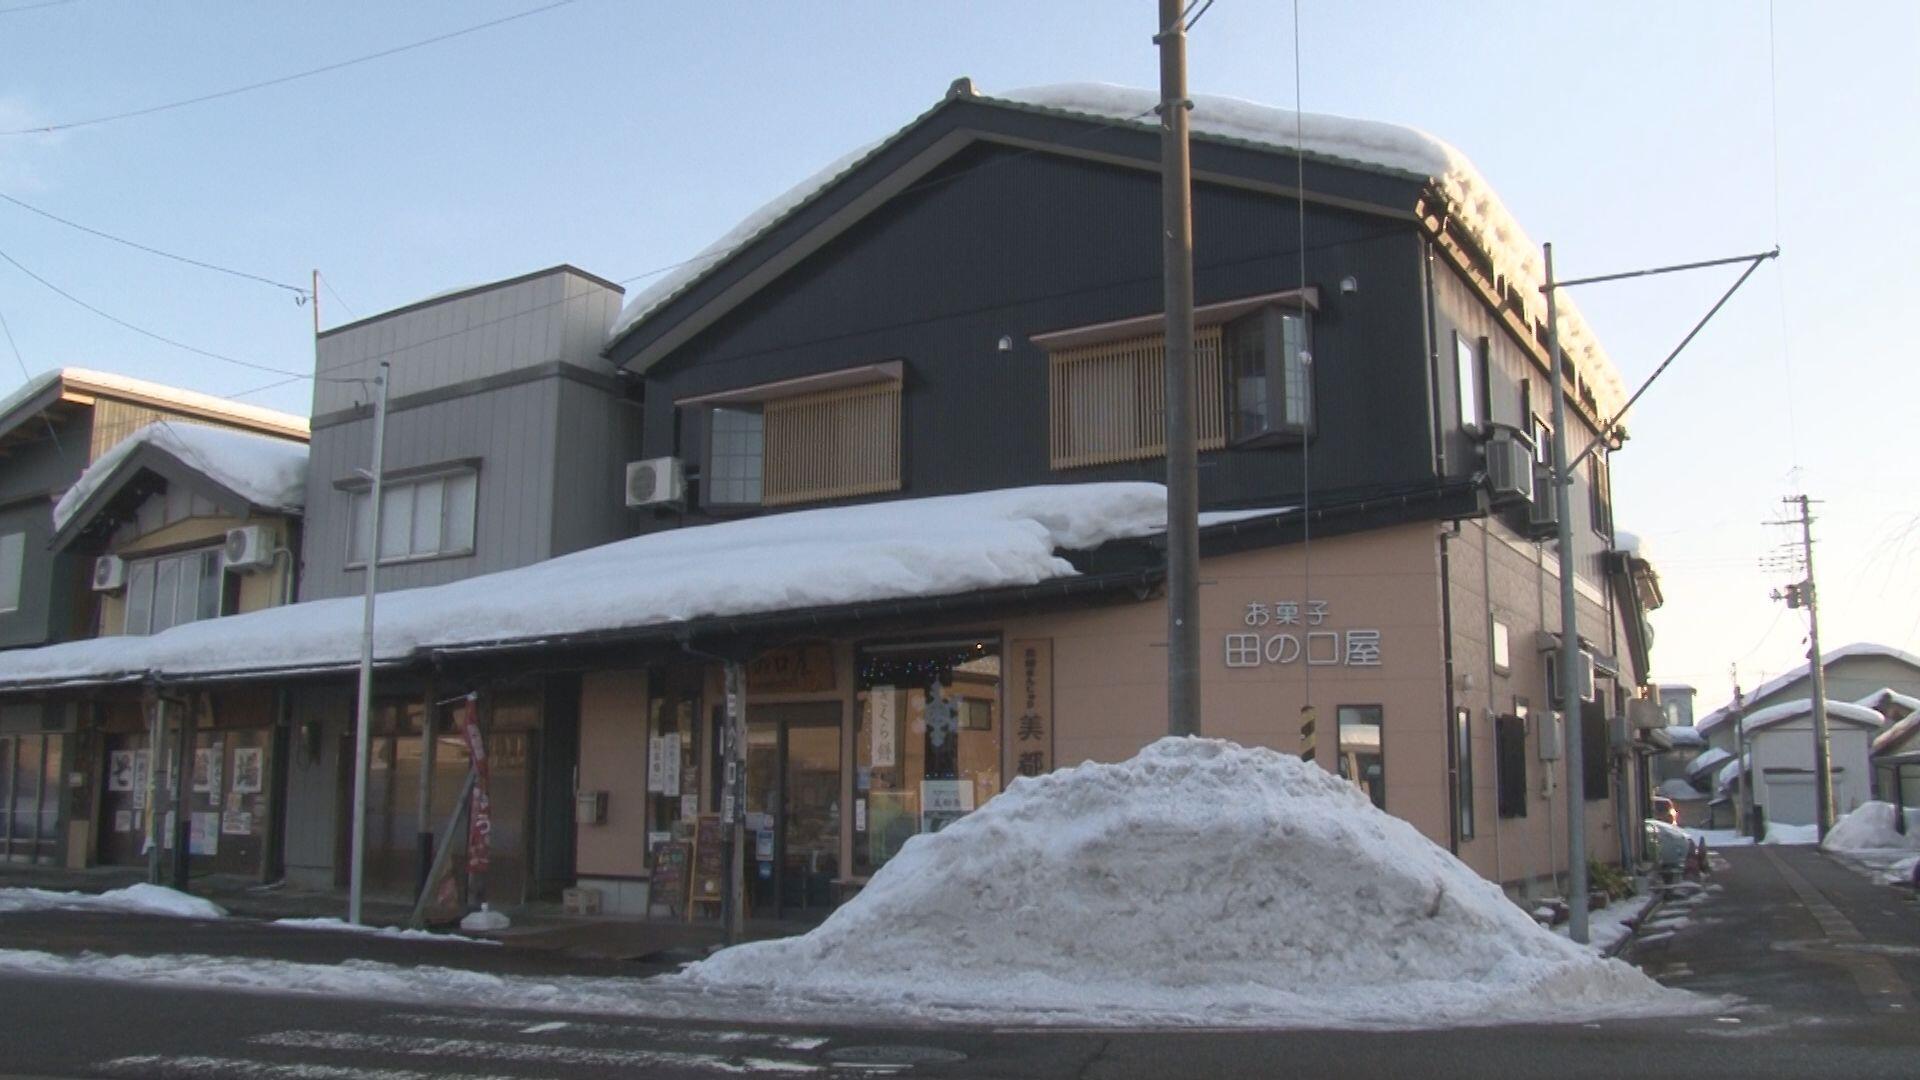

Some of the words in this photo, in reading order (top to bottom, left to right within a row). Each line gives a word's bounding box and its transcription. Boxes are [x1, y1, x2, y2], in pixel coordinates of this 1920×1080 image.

[1245, 601, 1330, 625] お菓子
[1225, 630, 1382, 666] 田の口屋
